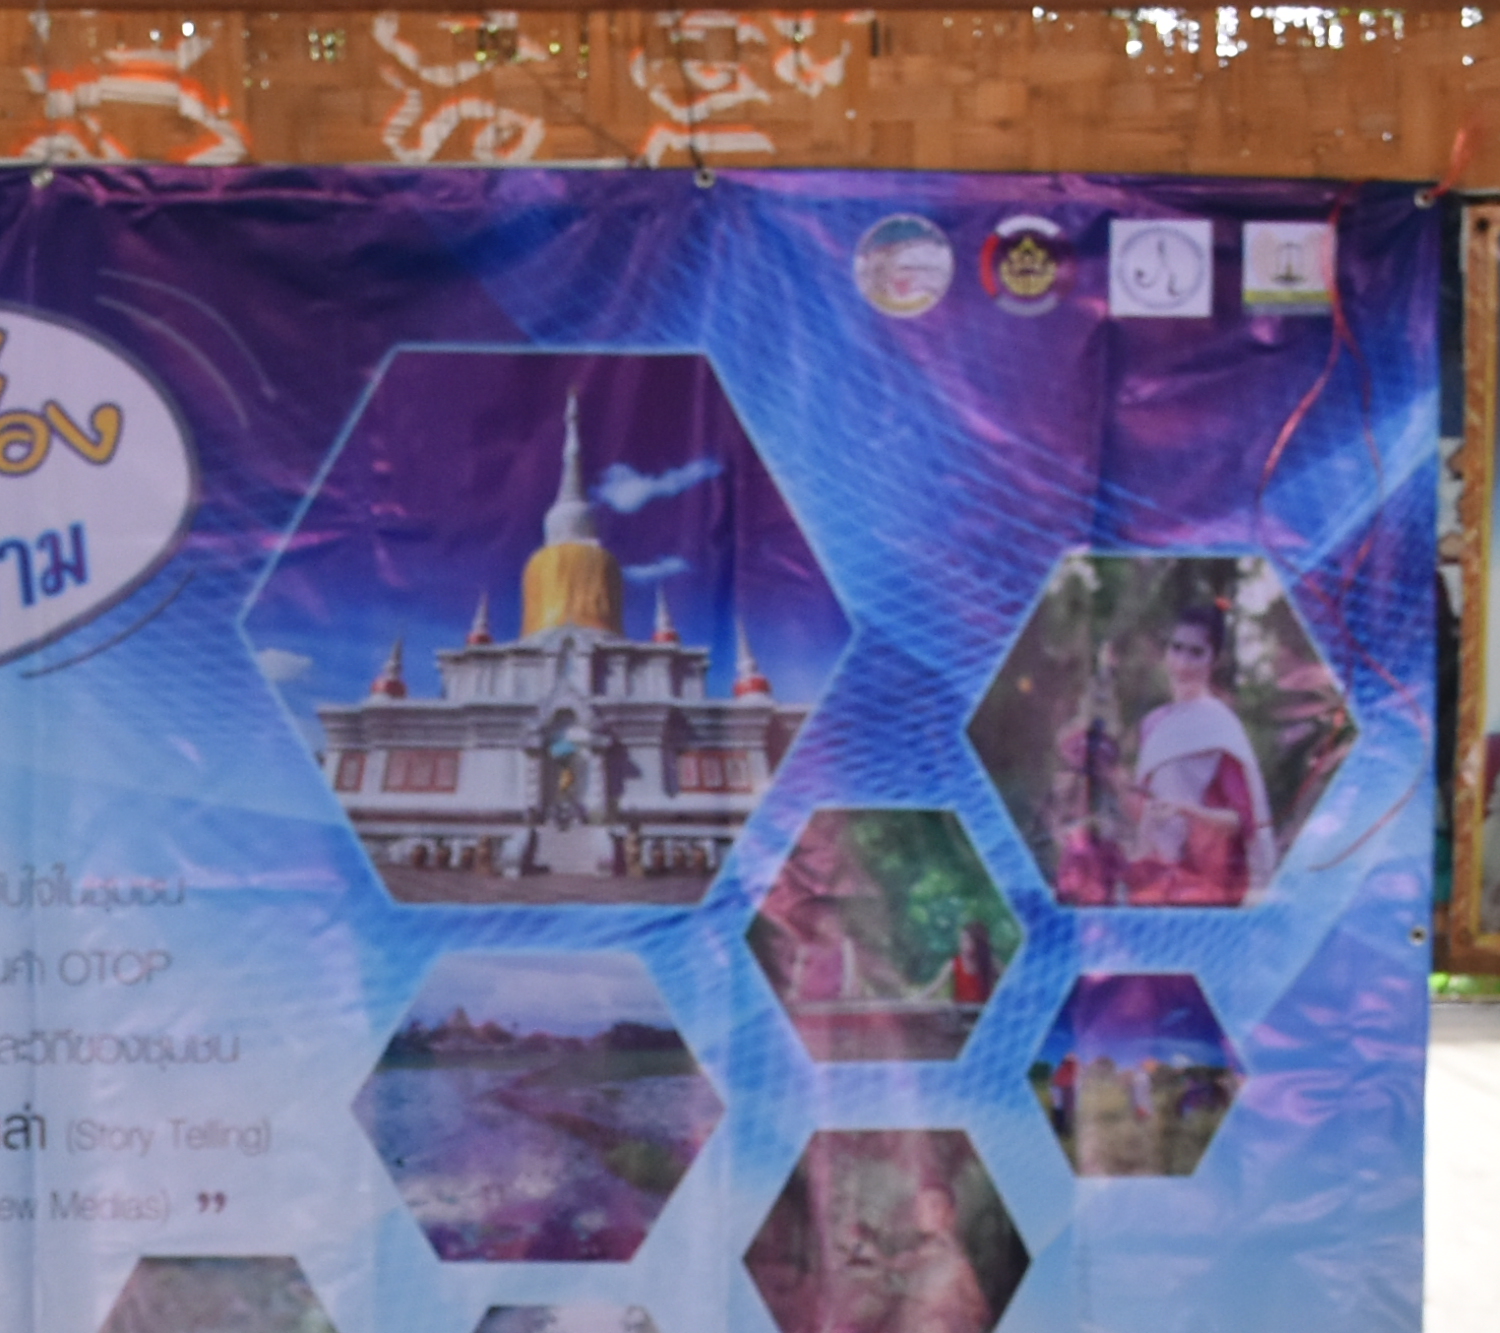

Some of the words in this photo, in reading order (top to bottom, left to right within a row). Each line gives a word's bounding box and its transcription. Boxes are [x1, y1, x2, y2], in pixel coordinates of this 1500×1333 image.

[59, 949, 174, 987] OTOP
[65, 1118, 155, 1157] (Story
[169, 1117, 272, 1157] Telling)
